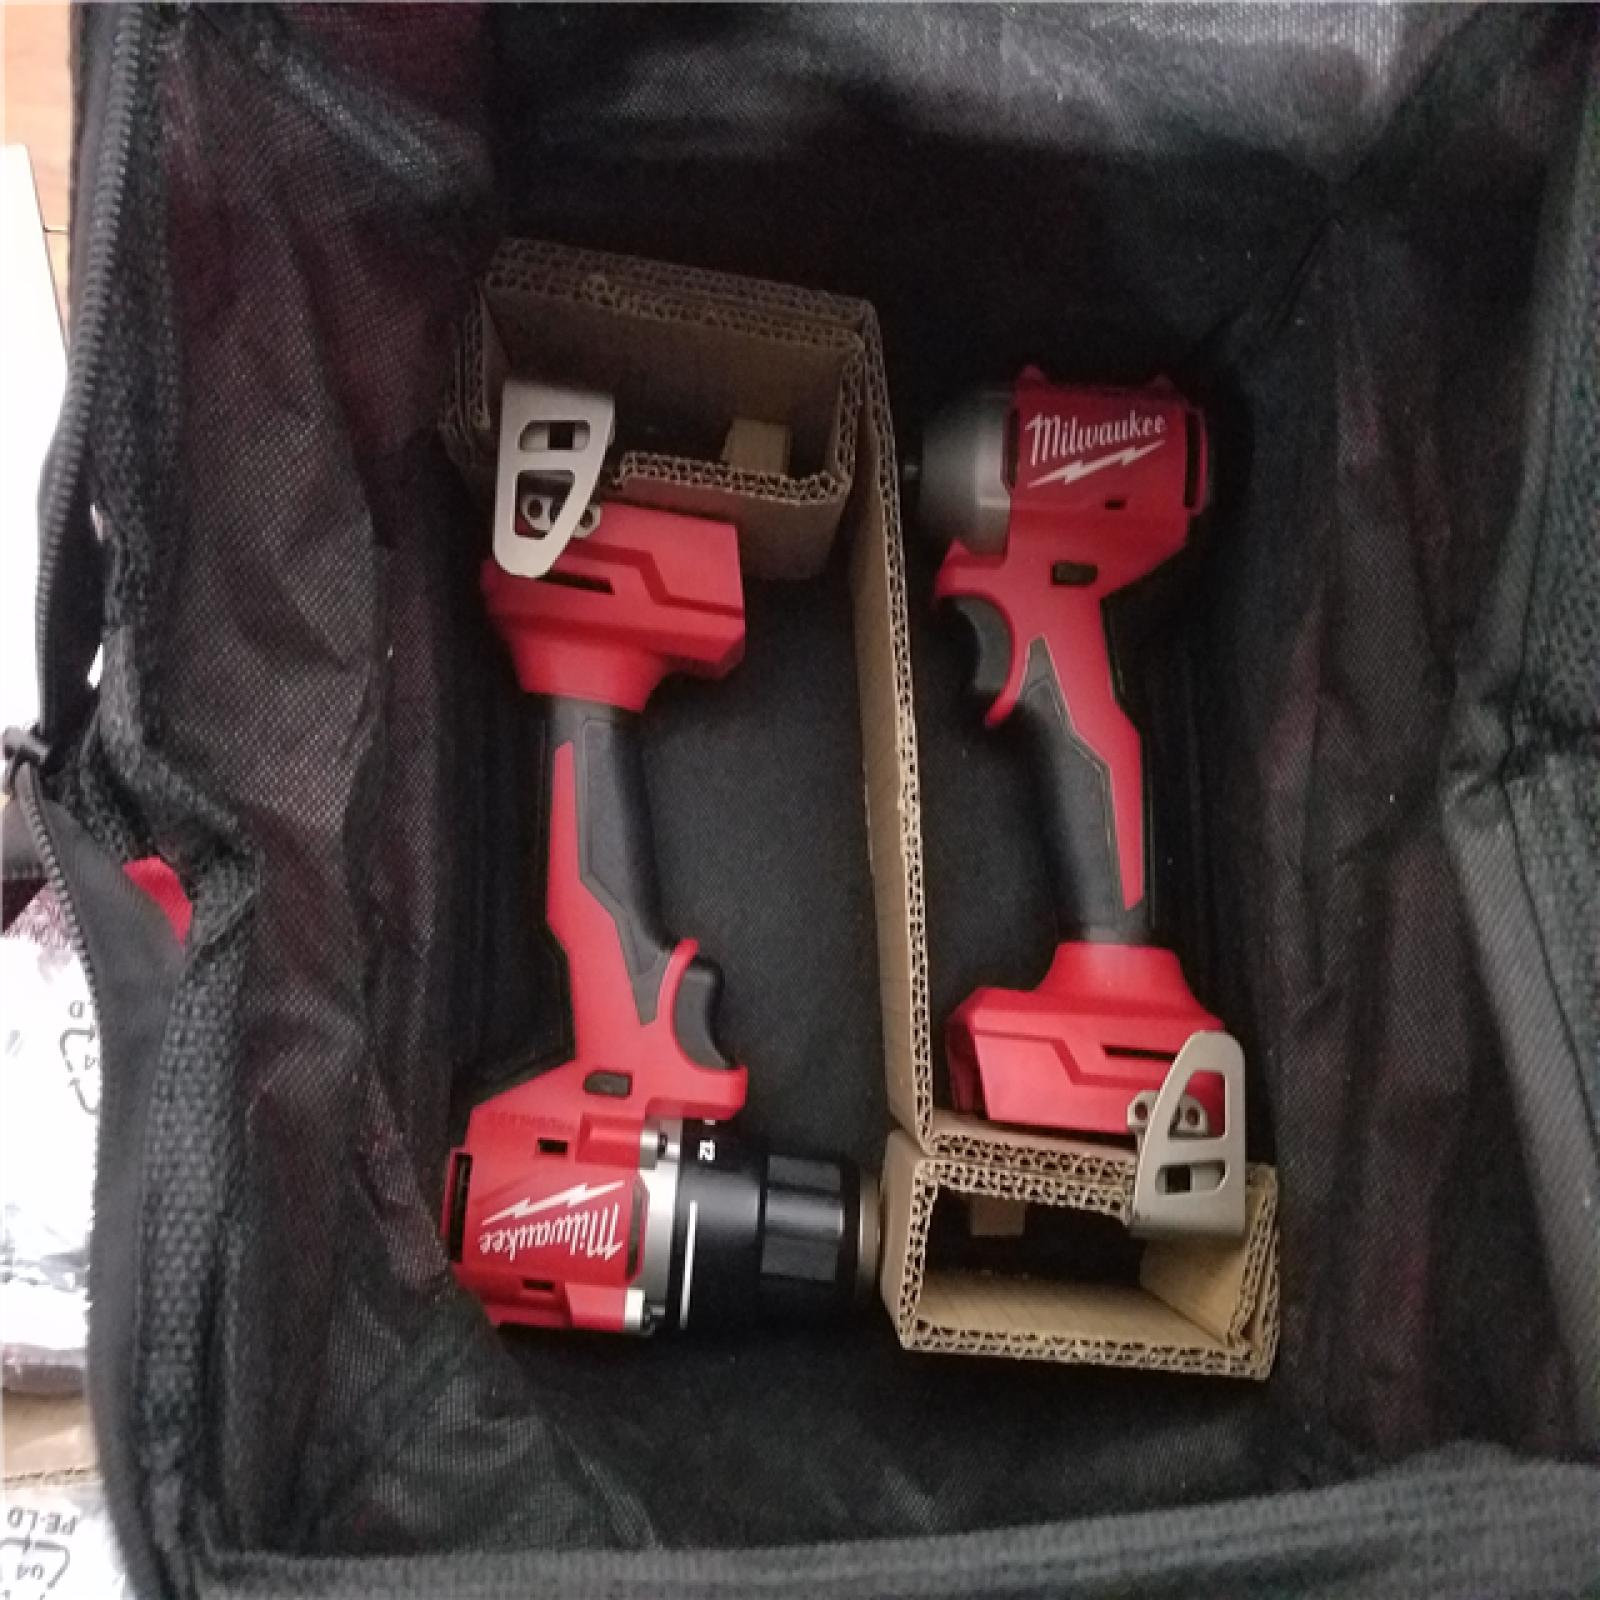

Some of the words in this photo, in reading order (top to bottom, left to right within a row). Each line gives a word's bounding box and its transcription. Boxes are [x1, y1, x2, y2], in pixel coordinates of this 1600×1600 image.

[1025, 409, 1166, 466] Milwaukee
[479, 1202, 624, 1262] Milwaukee
[7, 1506, 79, 1535] PE-LD
